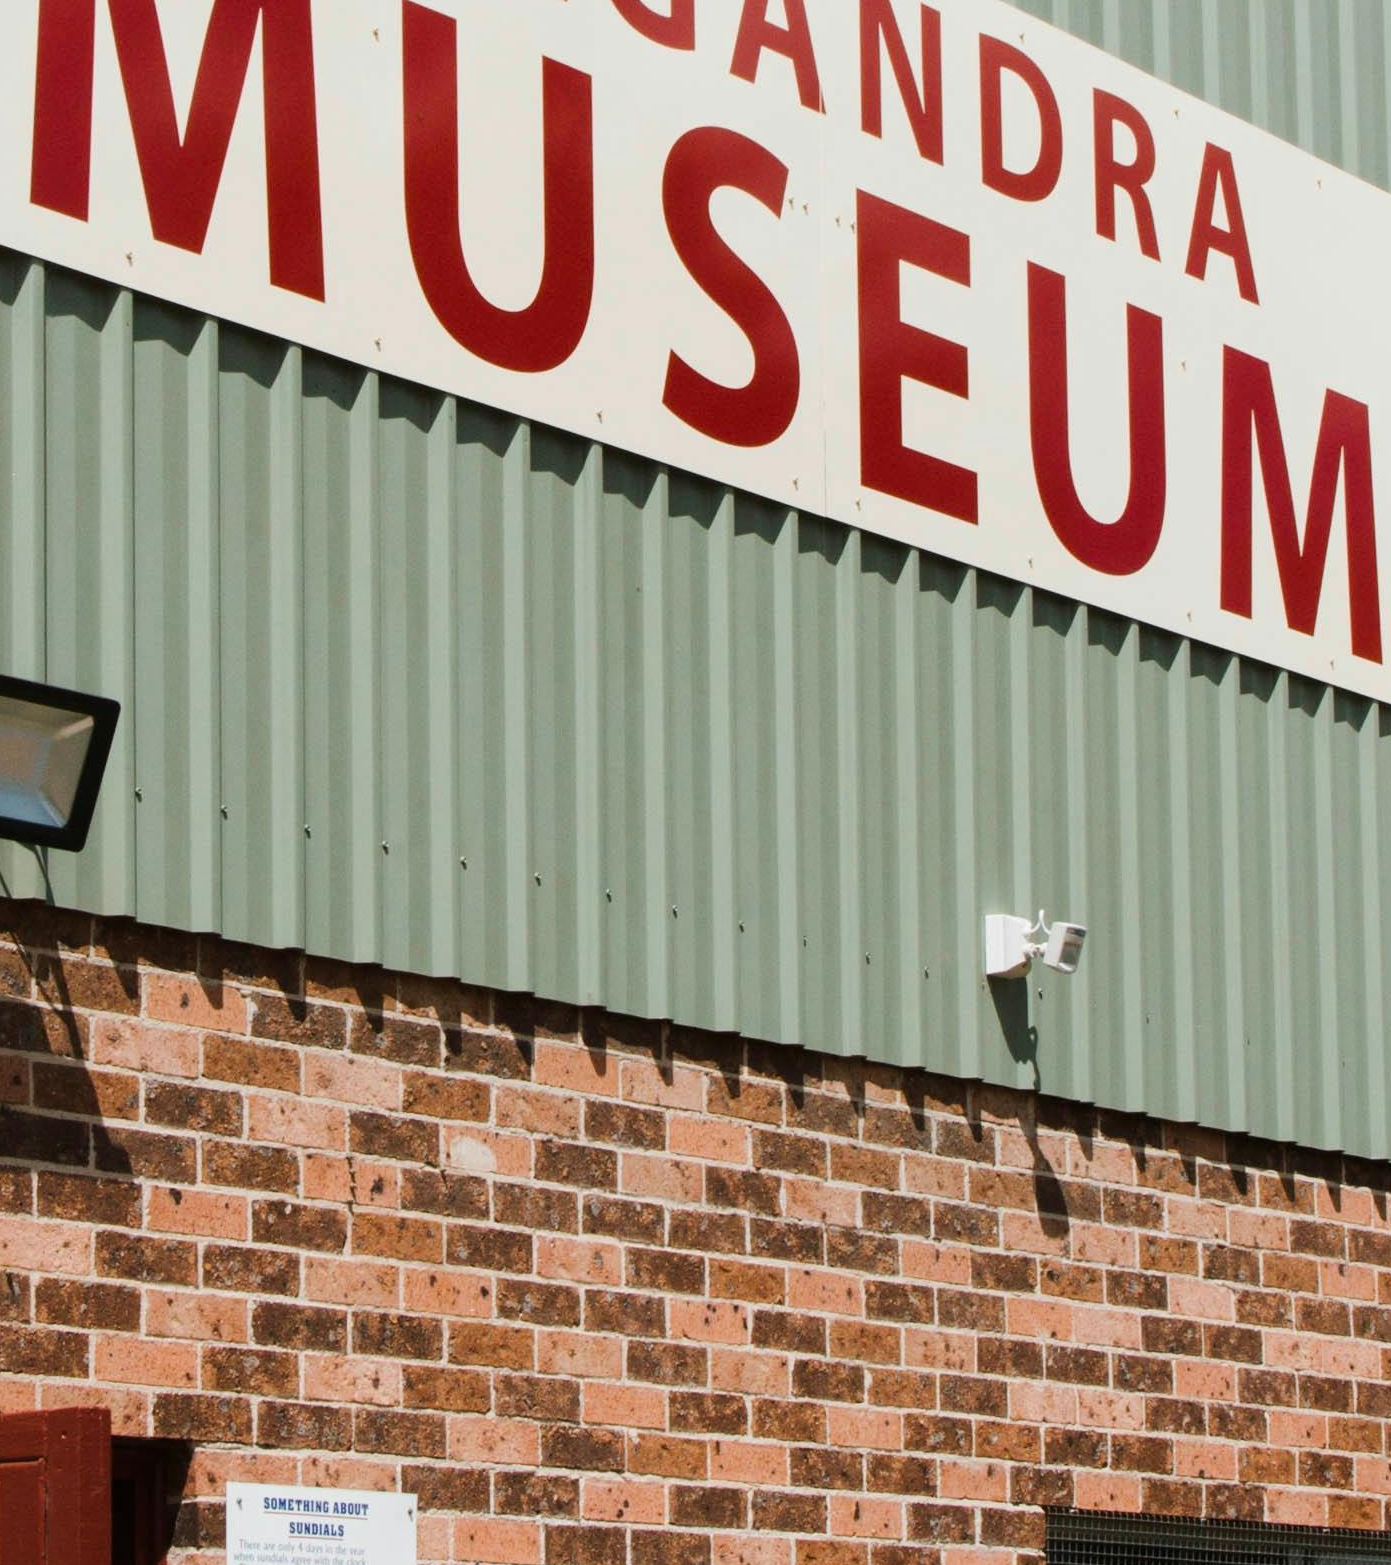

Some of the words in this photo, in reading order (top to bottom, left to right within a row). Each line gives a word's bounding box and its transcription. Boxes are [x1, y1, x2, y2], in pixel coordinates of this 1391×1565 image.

[263, 1497, 329, 1513] SOMETHING
[332, 1503, 369, 1516] ABOUT
[289, 1522, 345, 1537] SUNDIALS
[240, 1539, 259, 1550] There
[264, 1543, 274, 1551] are
[278, 1541, 294, 1555] only
[298, 1542, 303, 1552] 4
[306, 1542, 322, 1556] days
[335, 1544, 345, 1554] the
[234, 1551, 254, 1562] when
[257, 1552, 287, 1564] sundials
[314, 1555, 330, 1565] with
